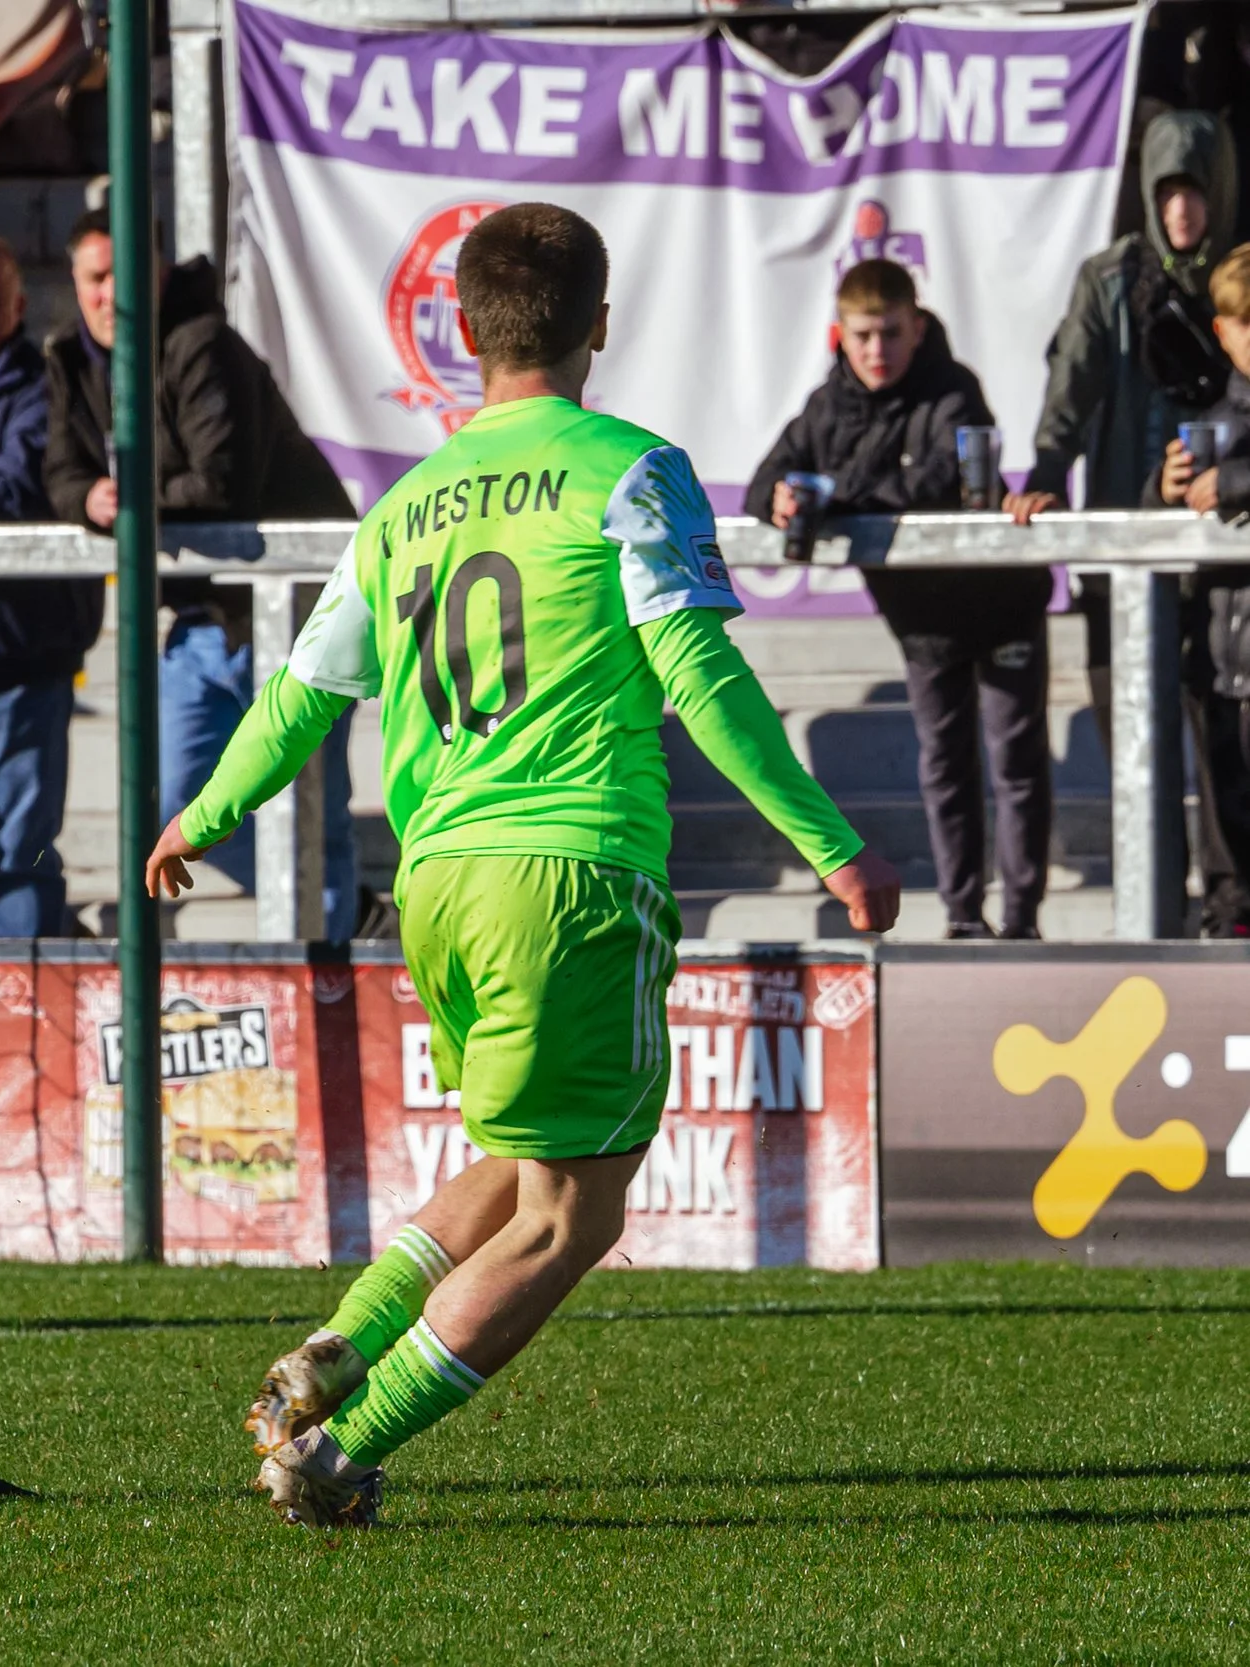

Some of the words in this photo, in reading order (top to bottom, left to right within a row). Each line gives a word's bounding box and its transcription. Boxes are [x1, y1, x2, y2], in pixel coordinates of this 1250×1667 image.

[280, 38, 587, 156] TAKE
[618, 64, 777, 164] ME
[788, 50, 1070, 167] HOME
[406, 469, 569, 542] WESTON
[396, 551, 528, 745] 10
[102, 1011, 268, 1082] RSTLERS
[667, 1025, 823, 1111] THAN
